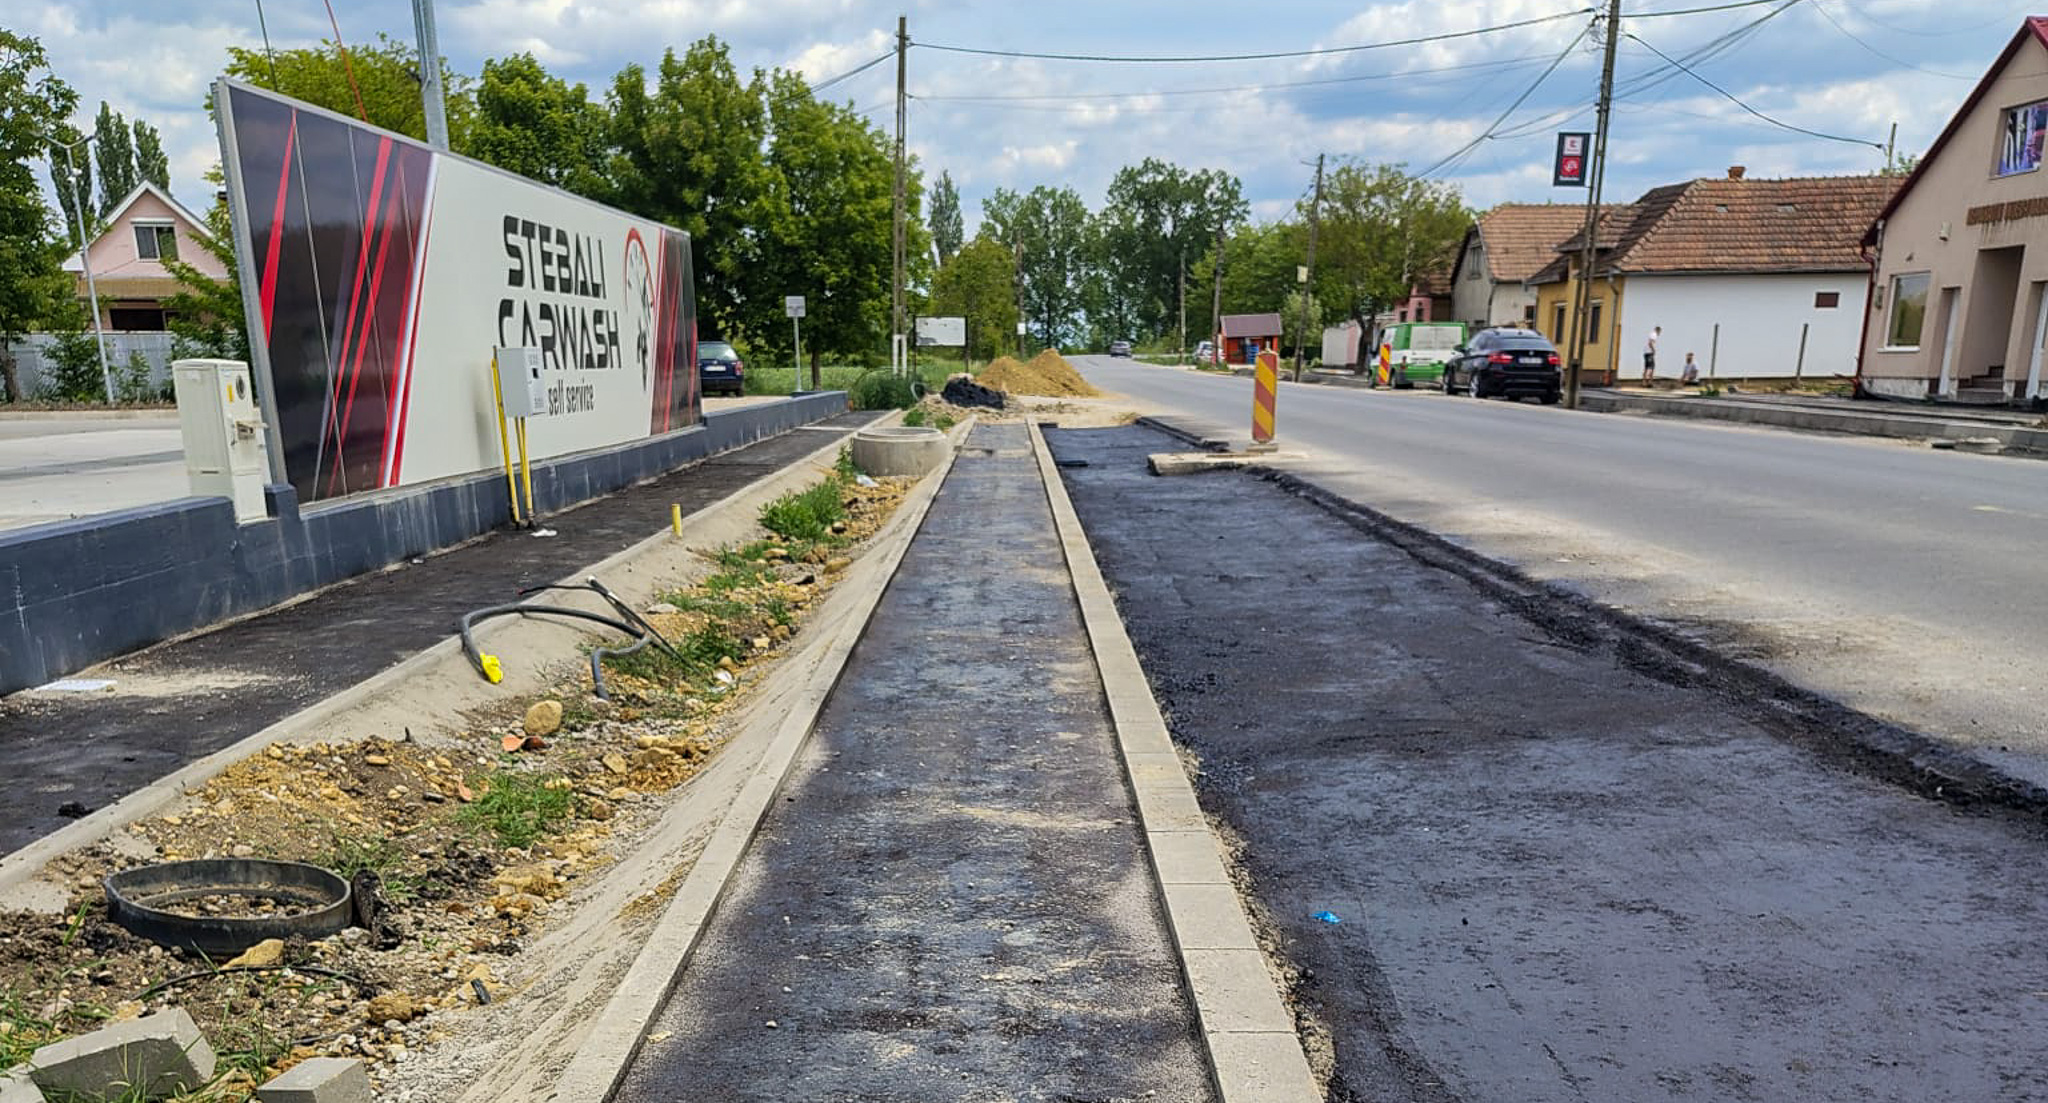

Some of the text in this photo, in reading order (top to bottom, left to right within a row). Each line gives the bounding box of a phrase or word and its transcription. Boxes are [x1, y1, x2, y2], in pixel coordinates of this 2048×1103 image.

[503, 214, 607, 300] STEBALI
[498, 298, 622, 370] CARWASH
[548, 377, 594, 416] self service
